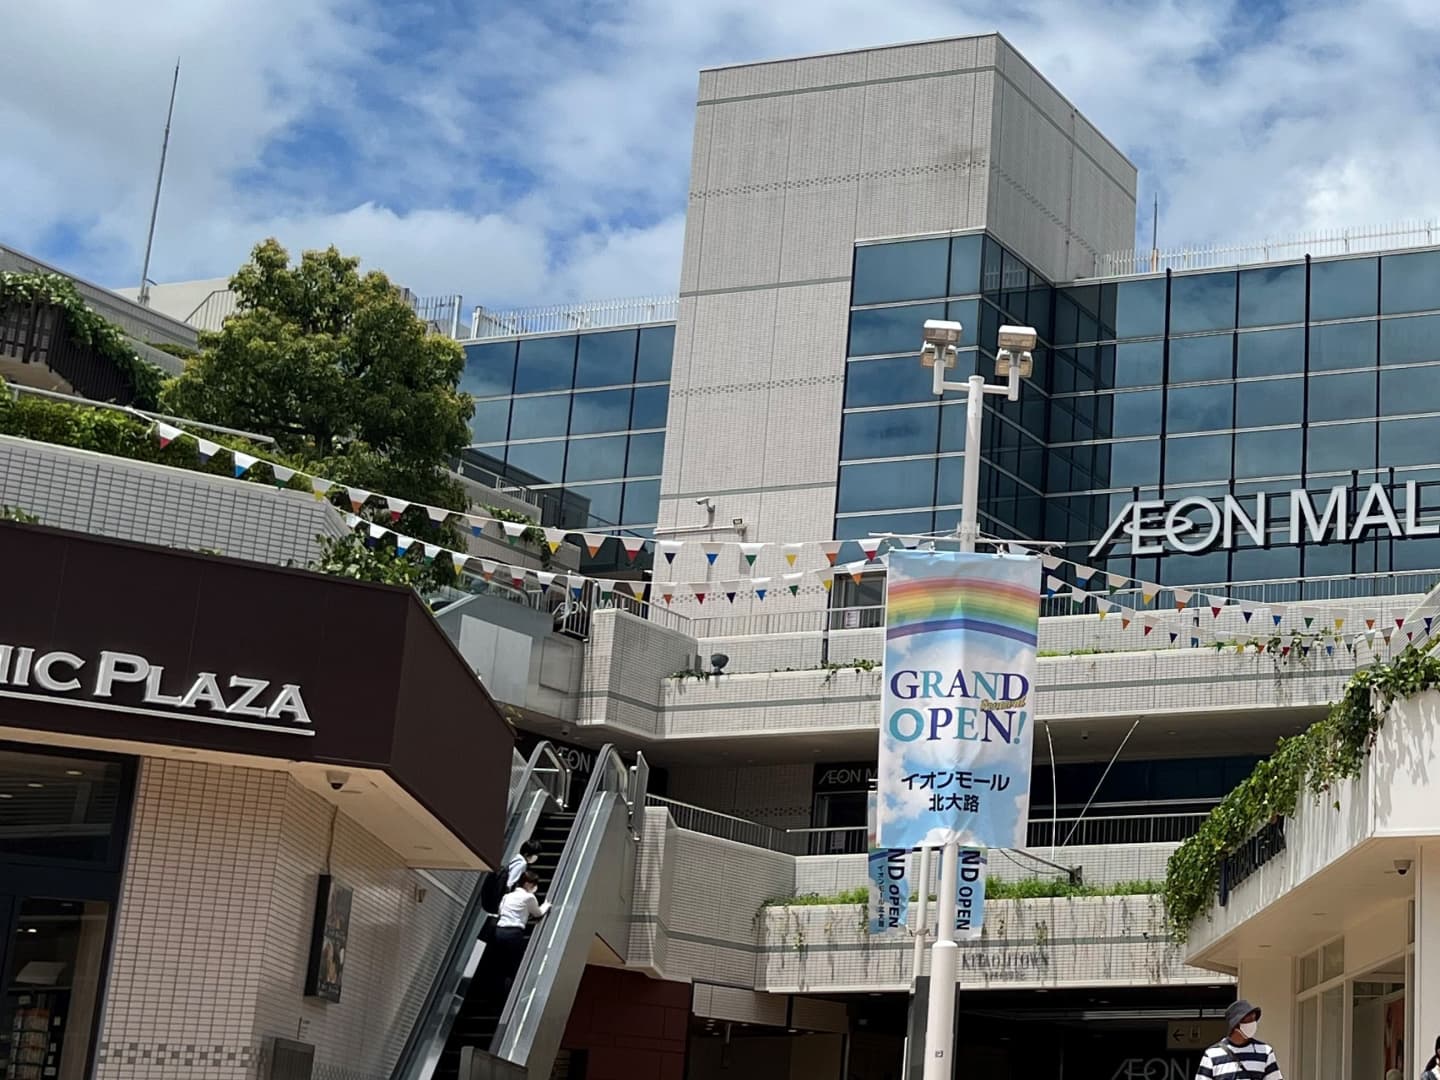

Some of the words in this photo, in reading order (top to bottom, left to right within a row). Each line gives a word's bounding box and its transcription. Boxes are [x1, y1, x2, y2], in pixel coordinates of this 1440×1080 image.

[93, 651, 312, 723] PLAZA
[890, 669, 1030, 700] GRAND
[889, 707, 1027, 745] OPEN!
[901, 771, 1010, 791] イオンモール
[929, 793, 979, 813] 北大路
[889, 884, 900, 928] OPEN
[956, 886, 973, 930] OPEN
